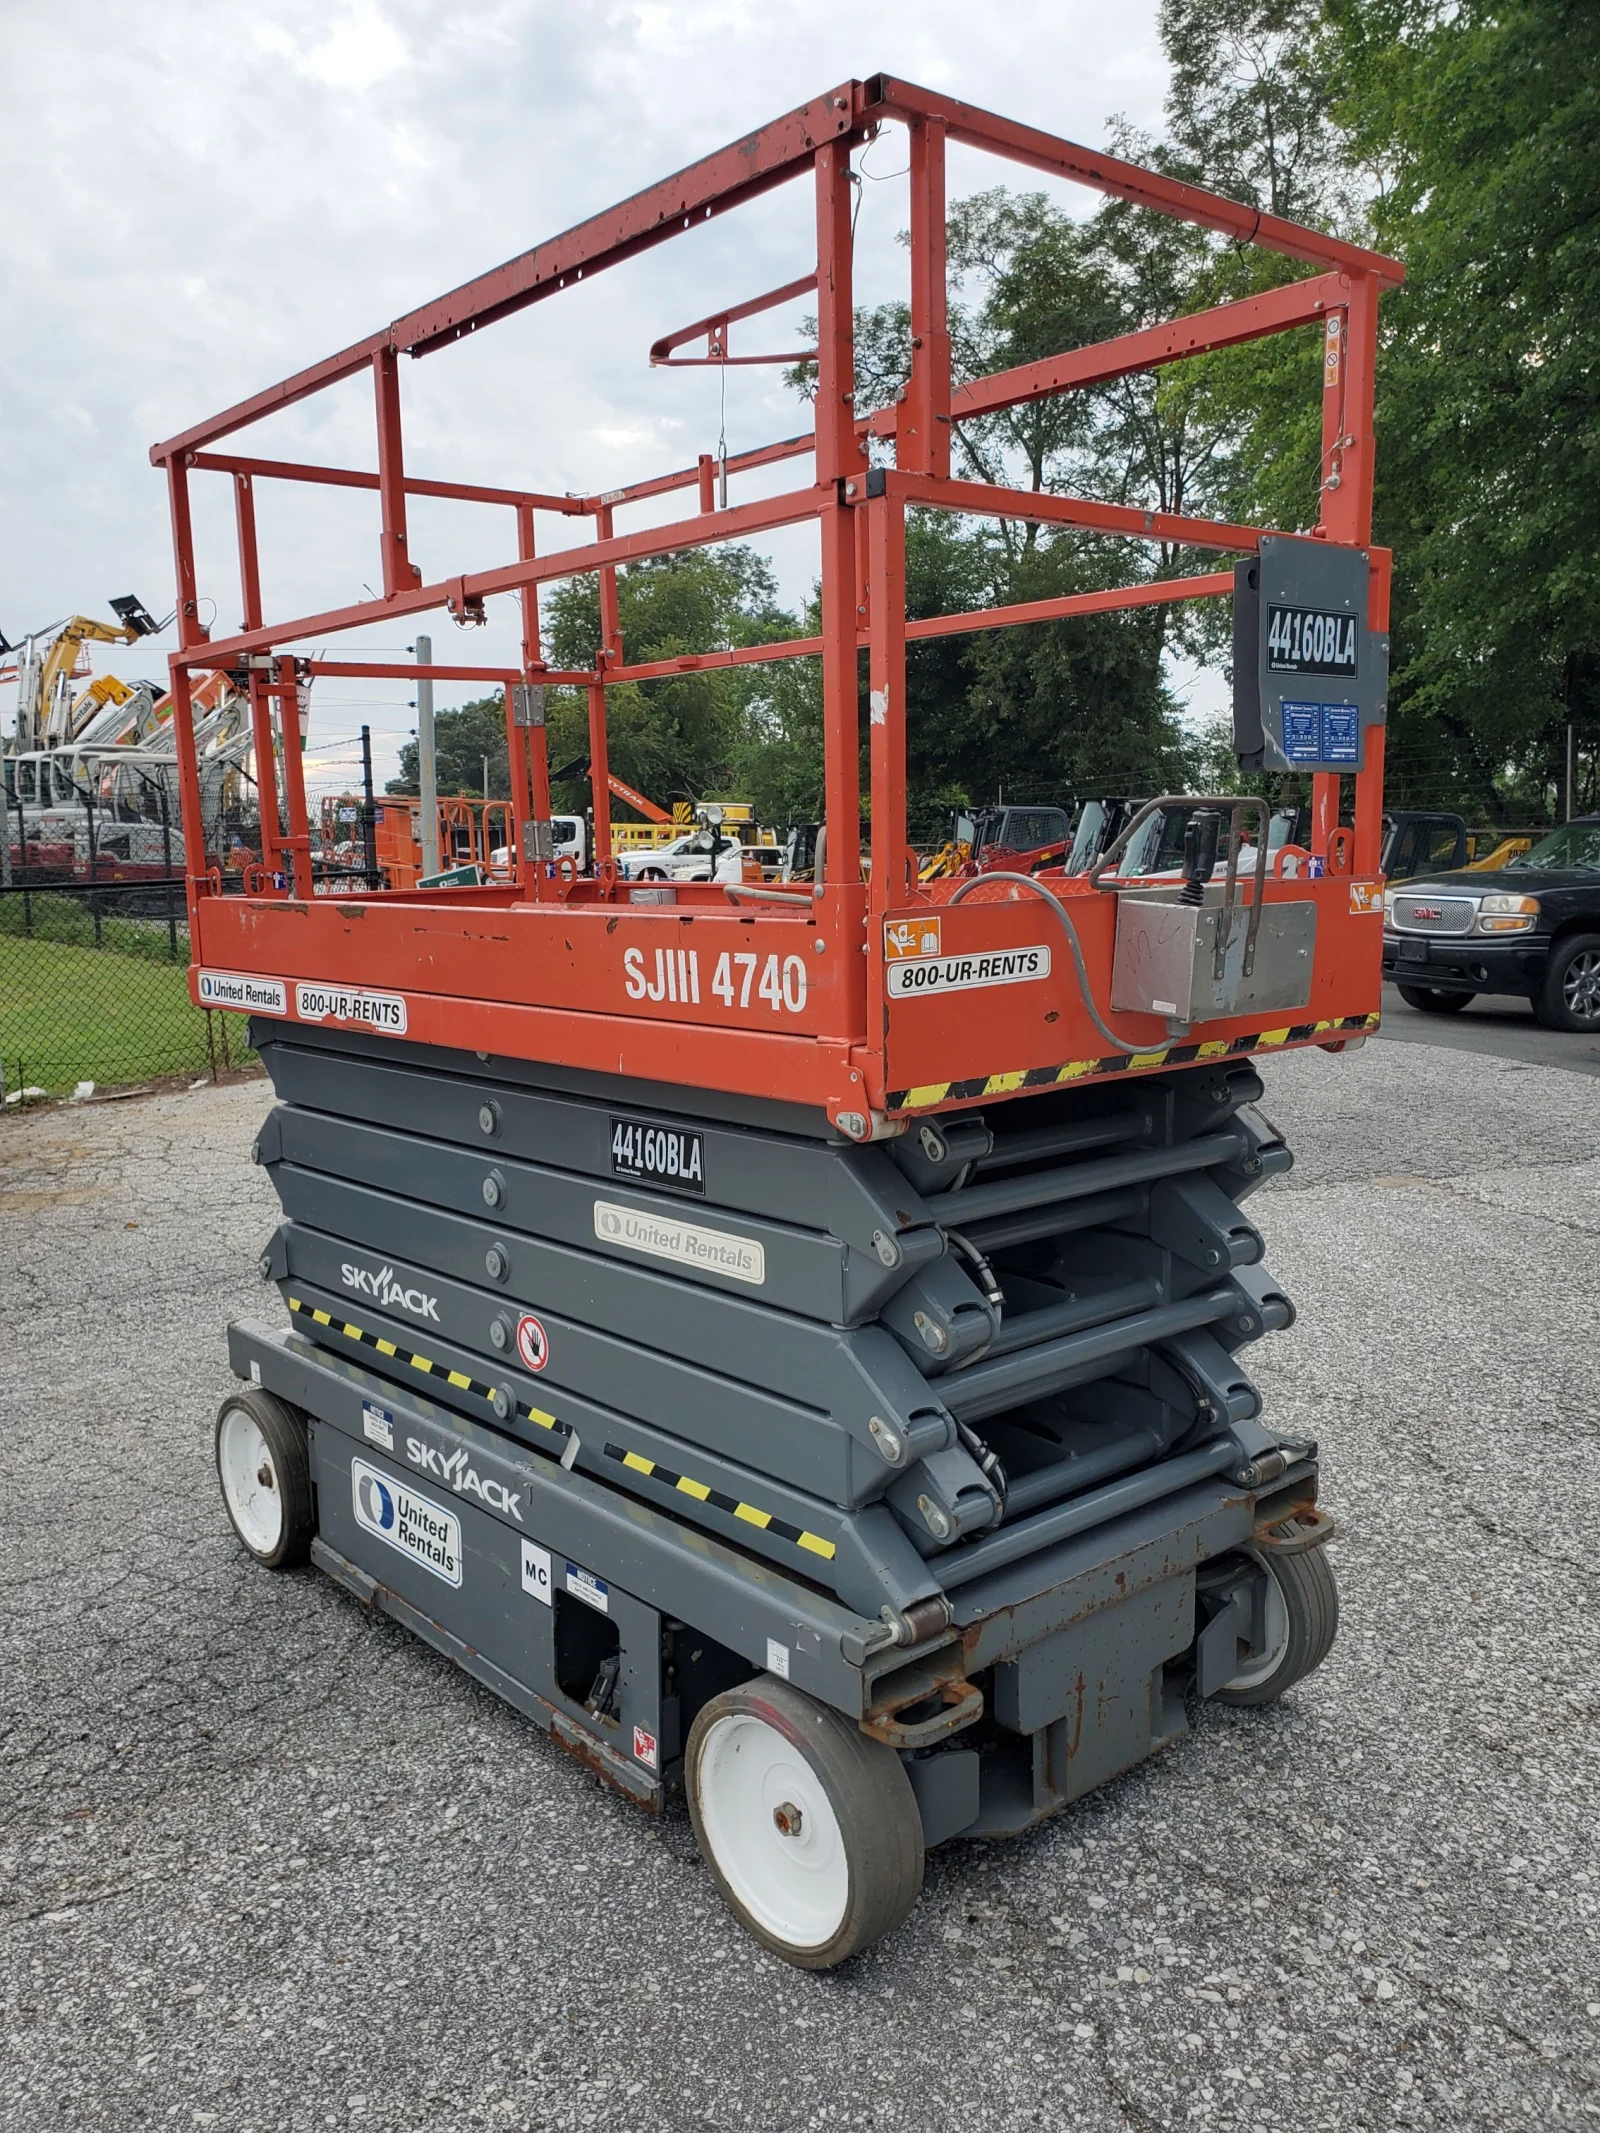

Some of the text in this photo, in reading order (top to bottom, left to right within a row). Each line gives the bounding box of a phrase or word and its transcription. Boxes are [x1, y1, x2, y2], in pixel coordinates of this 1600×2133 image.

[1268, 611, 1355, 665] 44160BLA
[72, 701, 93, 726] entals
[607, 778, 644, 806] KYTRAK
[1412, 907, 1443, 920] GMC
[711, 952, 807, 1013] 4740
[901, 952, 1039, 989] 800-UR-RENTS
[213, 980, 281, 1007] United Rentals
[302, 993, 400, 1025] 800-UR-RENTS
[612, 1123, 702, 1182] 44160BLA
[625, 1219, 753, 1271] United Rentals
[341, 1263, 441, 1322] SKYJACK
[406, 1437, 524, 1522] SKYJACK
[398, 1495, 449, 1543] United
[398, 1521, 454, 1572] Rentals
[525, 1559, 547, 1586] MC
[577, 1569, 597, 1588] NOTICE
